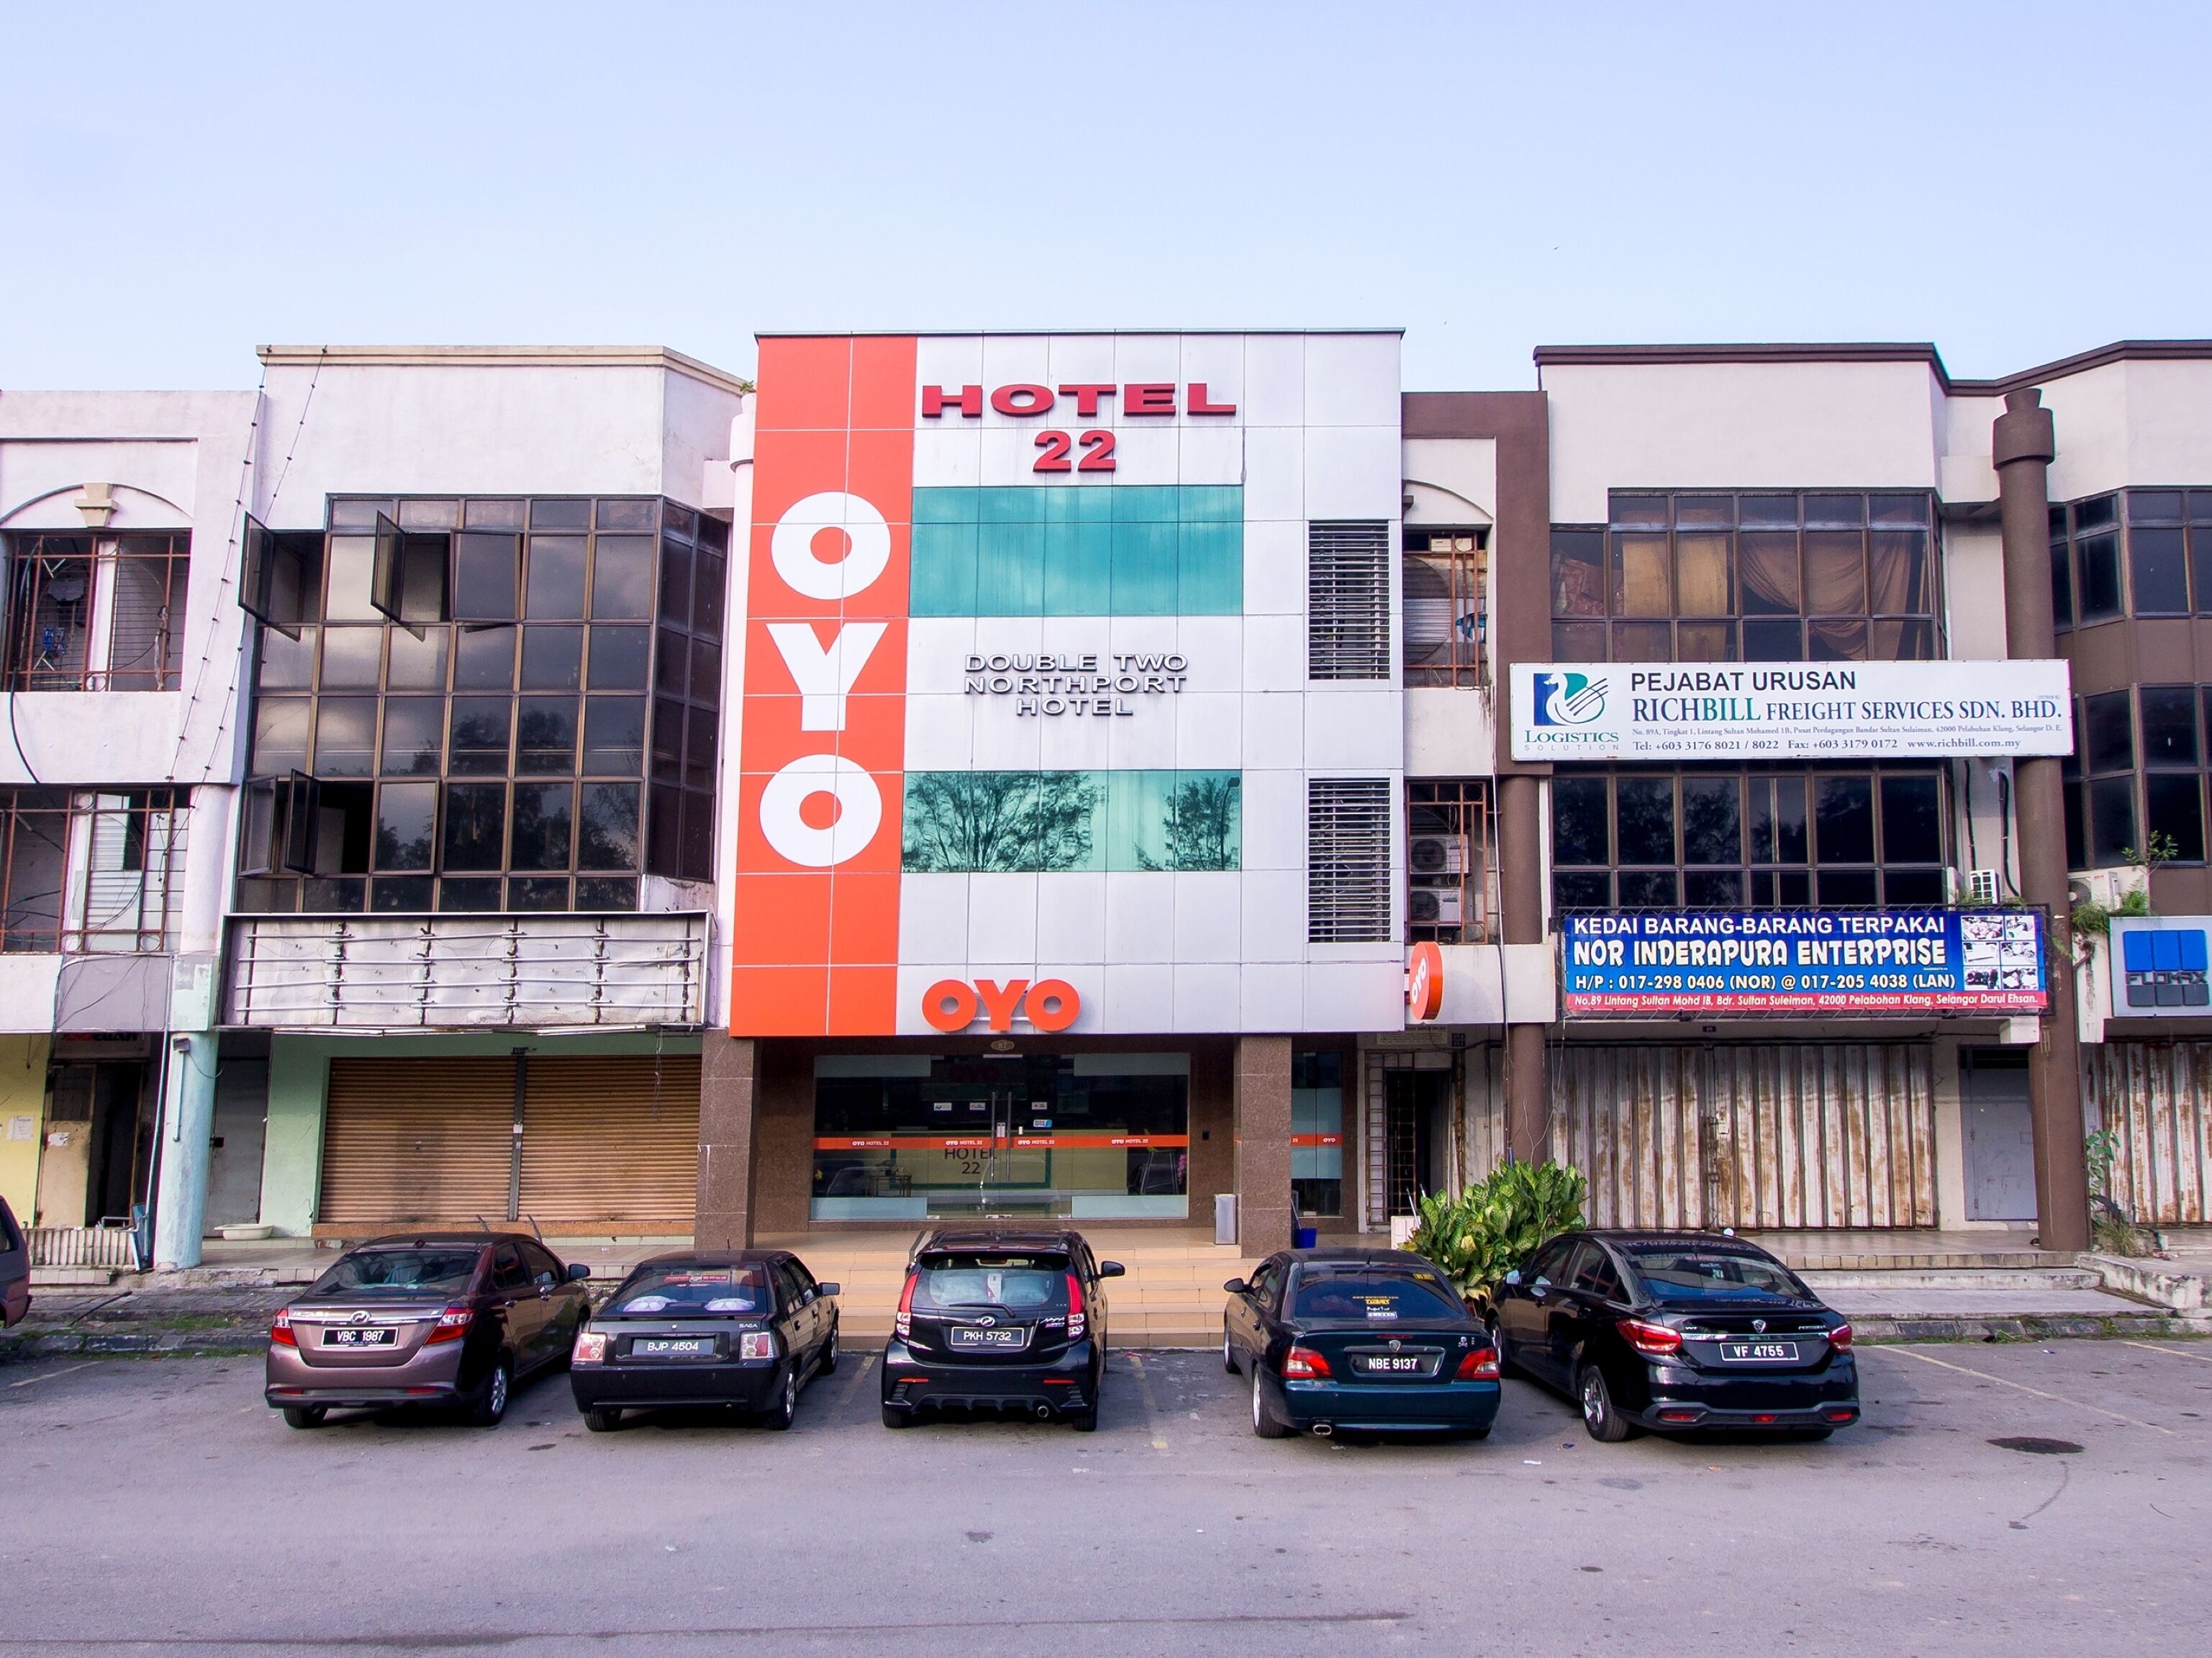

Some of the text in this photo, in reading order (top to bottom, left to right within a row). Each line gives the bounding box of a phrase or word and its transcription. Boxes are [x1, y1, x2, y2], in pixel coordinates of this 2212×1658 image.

[922, 383, 1236, 417] HOTEL
[1033, 430, 1117, 472] 22
[965, 653, 1187, 672] DOUBLE TWO
[759, 490, 891, 868] OYO
[964, 676, 1187, 694] NORTHPORT
[1631, 671, 1856, 691] PEJABAT URUSAN
[1016, 698, 1133, 716] HOTEL
[1632, 697, 2062, 722] RICHBILL FREIGHT SERVICES SDN. BHD.
[1525, 730, 1619, 743] LOGISTICS
[1662, 728, 1688, 737] Tingkat
[1813, 727, 1854, 735] Perdagangan
[1633, 741, 1651, 750] Tel:
[1655, 740, 1682, 750] +603
[1685, 740, 1711, 750] 3176
[1714, 740, 1741, 750] 8021
[1752, 740, 1779, 749] 8022
[1787, 740, 1809, 749] Fax:
[1813, 740, 1839, 749] +603
[1841, 740, 1869, 748] 3179
[1871, 740, 1898, 748] 0172
[1907, 738, 2021, 749] www.richbill.com.my
[1574, 917, 1944, 934] KEDAI BARANG-BARANG TERPAKAI
[1574, 938, 1946, 967] NOR INDERAPURA ENTERPRISE
[1411, 957, 1427, 1005] OYO
[1575, 975, 1604, 989] H/P
[1618, 975, 1682, 989] 017-298
[1687, 974, 1724, 989] 0406
[1730, 974, 1776, 990] (NOR)
[1781, 975, 1796, 990] @
[1801, 974, 1864, 989] 017-205
[1870, 974, 1908, 989] 4038
[1913, 974, 1956, 989] (LAN)
[922, 979, 1081, 1032] OYO
[1604, 995, 1638, 1007] Lintang
[1641, 995, 1670, 1006] Sultan
[1672, 995, 1700, 1006] Mohd
[1716, 995, 1735, 1006] Bdr.
[1738, 995, 1767, 1006] Sultan
[1769, 994, 1815, 1007] Suleiman,
[1818, 995, 1846, 1005] 42000
[1849, 994, 1900, 1005] Pelabohan
[1903, 994, 1934, 1007] Klang,
[1936, 994, 1978, 1006] Selangor
[1980, 994, 2005, 1005] Darul
[2008, 993, 2038, 1004] Ehsan.
[961, 1161, 980, 1174] 22
[337, 1329, 385, 1343] VBC 1987
[964, 1331, 1012, 1341] PKH 5732
[647, 1341, 699, 1351] BJP 4504
[1733, 1344, 1785, 1357] VF 4755
[1369, 1358, 1418, 1369] NBE 9137
